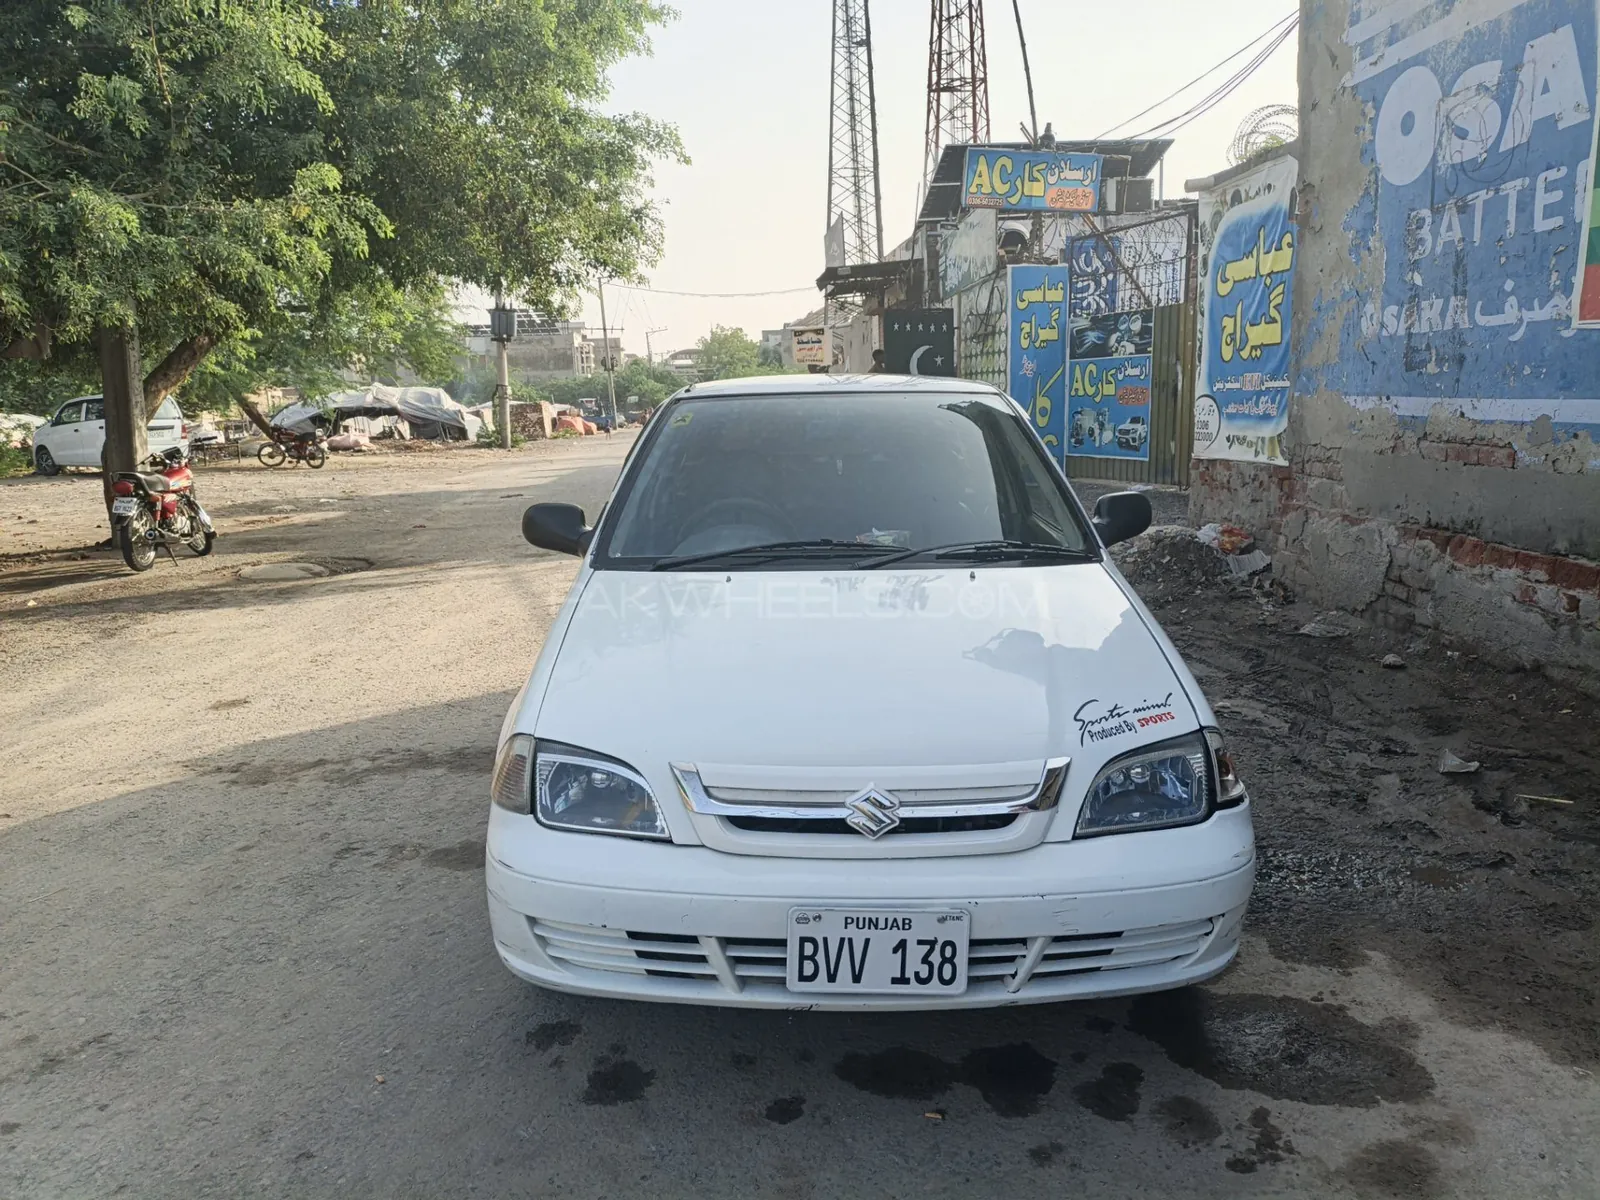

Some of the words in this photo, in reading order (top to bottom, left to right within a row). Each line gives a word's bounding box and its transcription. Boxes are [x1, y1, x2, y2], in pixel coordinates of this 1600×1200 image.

[968, 154, 1013, 195] AC
[1007, 161, 1048, 205] کار
[1048, 158, 1097, 186] ارسلان
[1216, 225, 1294, 297] عباسی
[1016, 274, 1064, 311] عباسی
[1020, 307, 1060, 350] گیراج
[1220, 281, 1286, 363] گیراج
[1070, 362, 1097, 397] AC
[1093, 367, 1117, 403] کار
[1117, 358, 1150, 380] ارسلان
[1087, 723, 1126, 742] Produced
[1123, 720, 1138, 734] By
[1137, 711, 1175, 728] SPORTS
[844, 916, 913, 931] PUNJAB
[798, 936, 871, 984] BVV
[890, 937, 957, 986] 138
